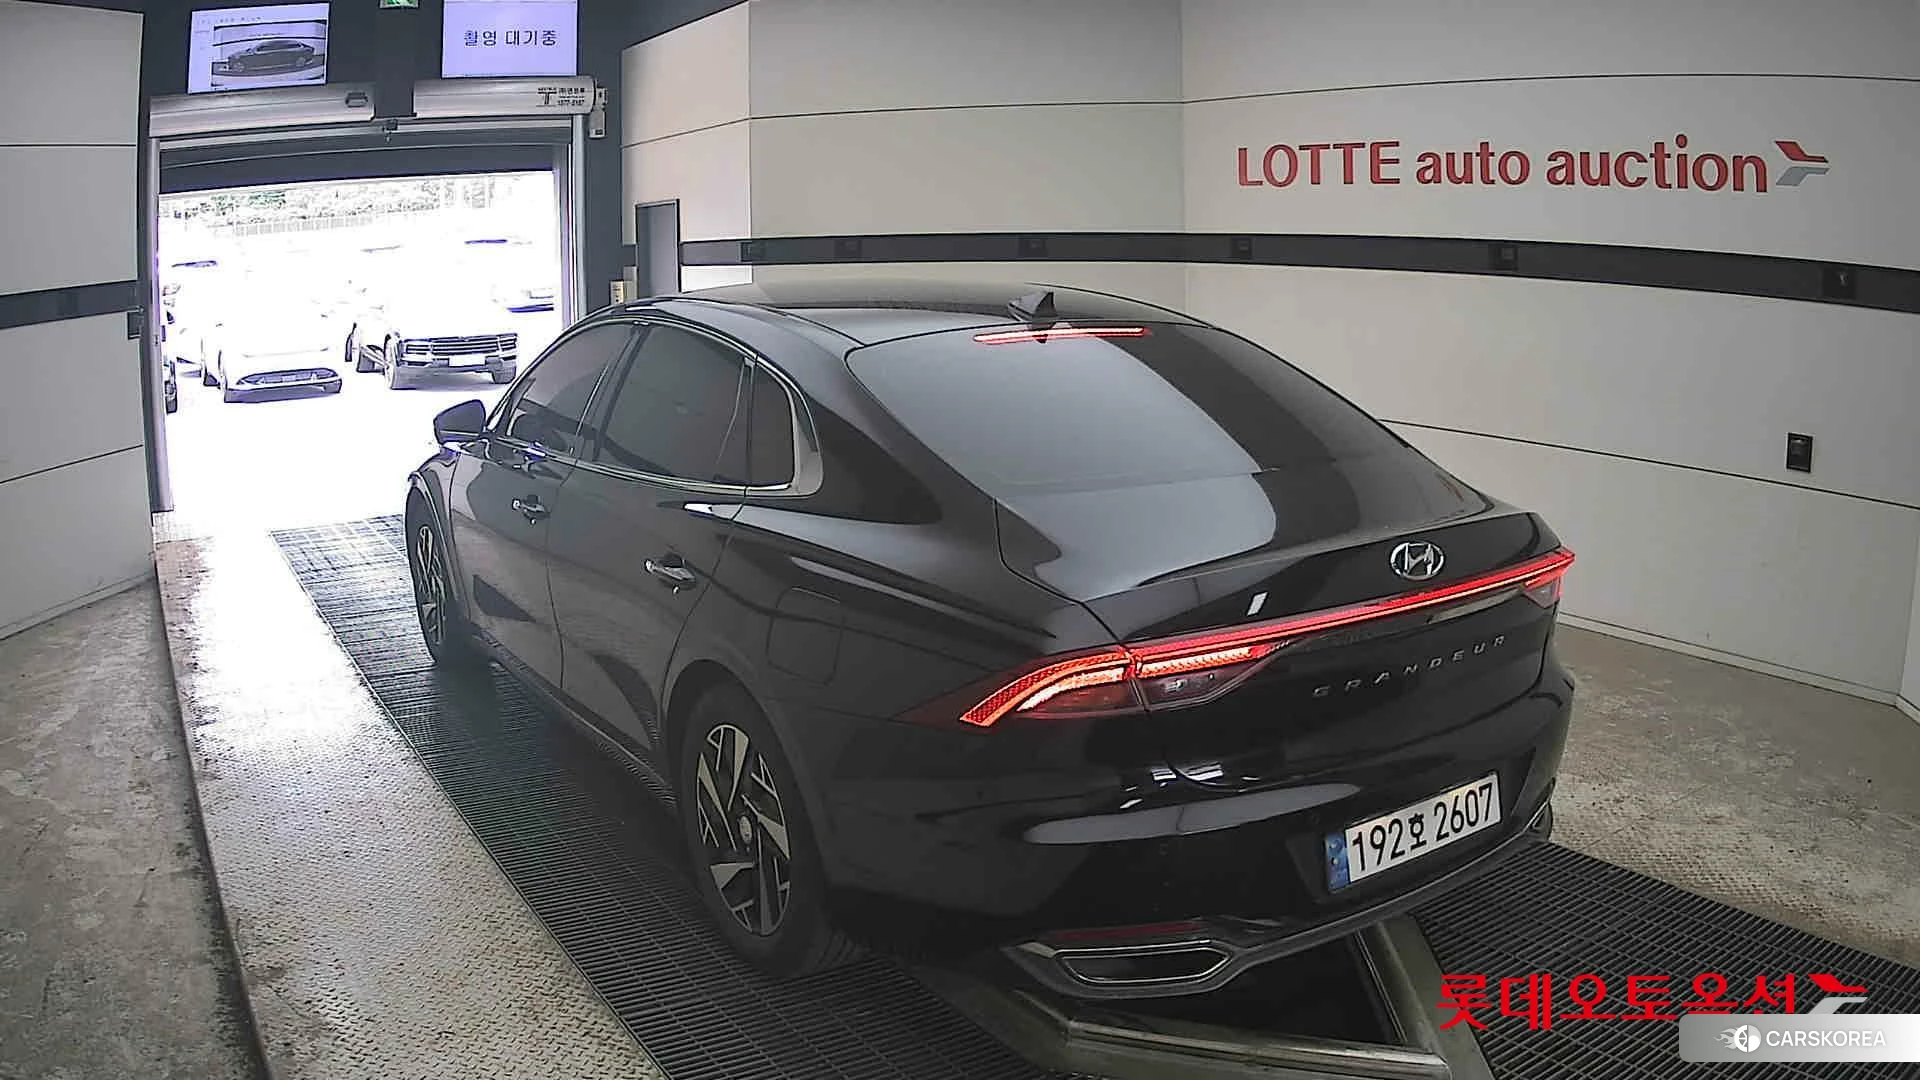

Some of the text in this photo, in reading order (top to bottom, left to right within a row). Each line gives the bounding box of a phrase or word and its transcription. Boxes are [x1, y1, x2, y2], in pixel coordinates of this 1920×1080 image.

[505, 30, 556, 46] 대기중
[1238, 134, 1768, 193] LOTTE auto auction
[1312, 635, 1505, 697] GRANDEUR
[1352, 782, 1493, 871] 192호 2607
